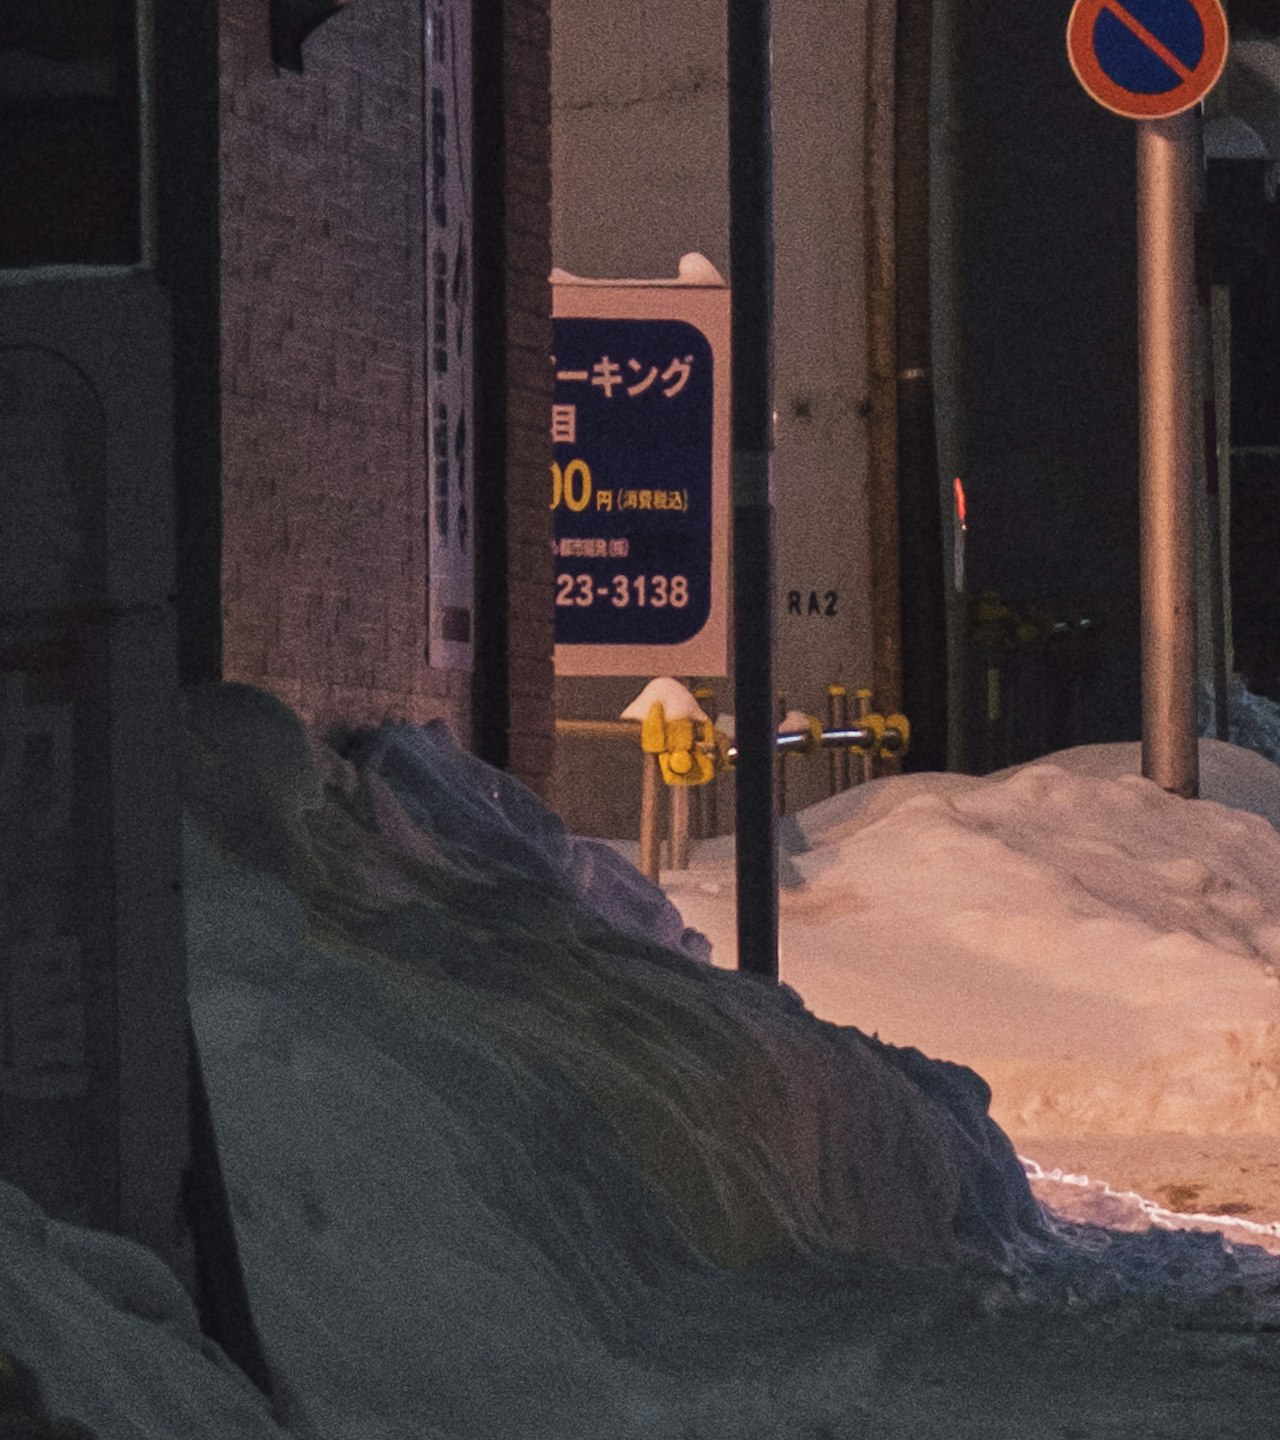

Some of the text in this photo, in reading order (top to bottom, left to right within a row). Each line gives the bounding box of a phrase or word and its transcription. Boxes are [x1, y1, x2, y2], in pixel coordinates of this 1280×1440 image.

[551, 355, 695, 400] ーキング
[556, 573, 689, 608] 23-3138
[788, 589, 839, 616] RA2
